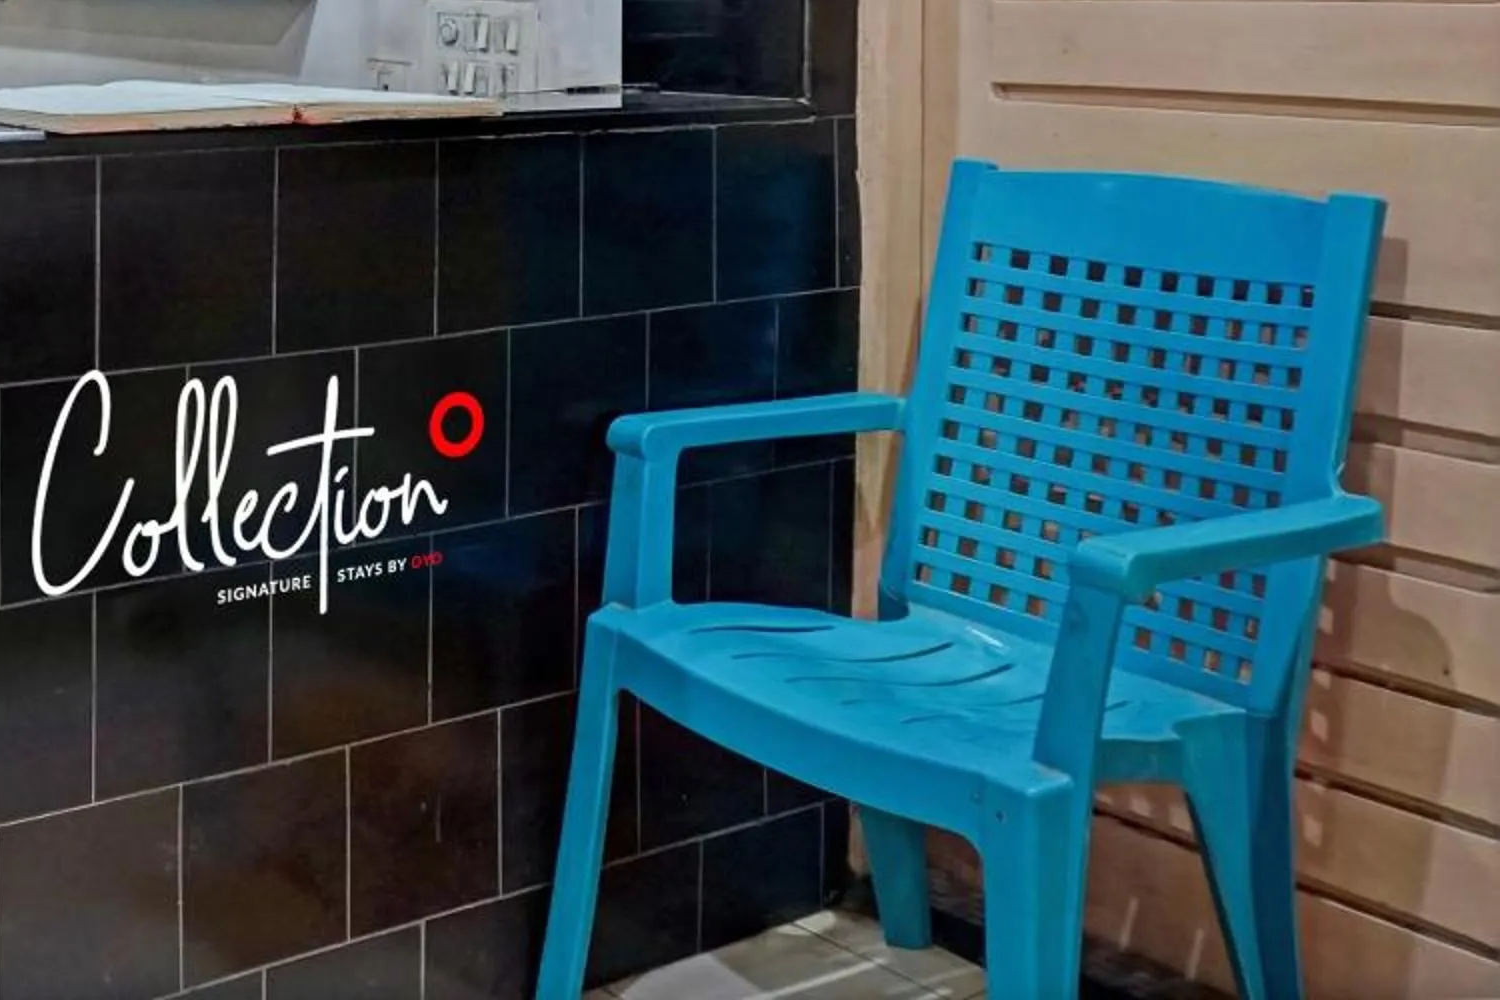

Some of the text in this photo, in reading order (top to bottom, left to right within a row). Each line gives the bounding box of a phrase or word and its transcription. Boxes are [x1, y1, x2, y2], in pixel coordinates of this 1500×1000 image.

[32, 369, 449, 614] Collection
[217, 574, 312, 605] SIGNATURE
[336, 561, 384, 584] STAYS
[387, 557, 408, 574] BY
